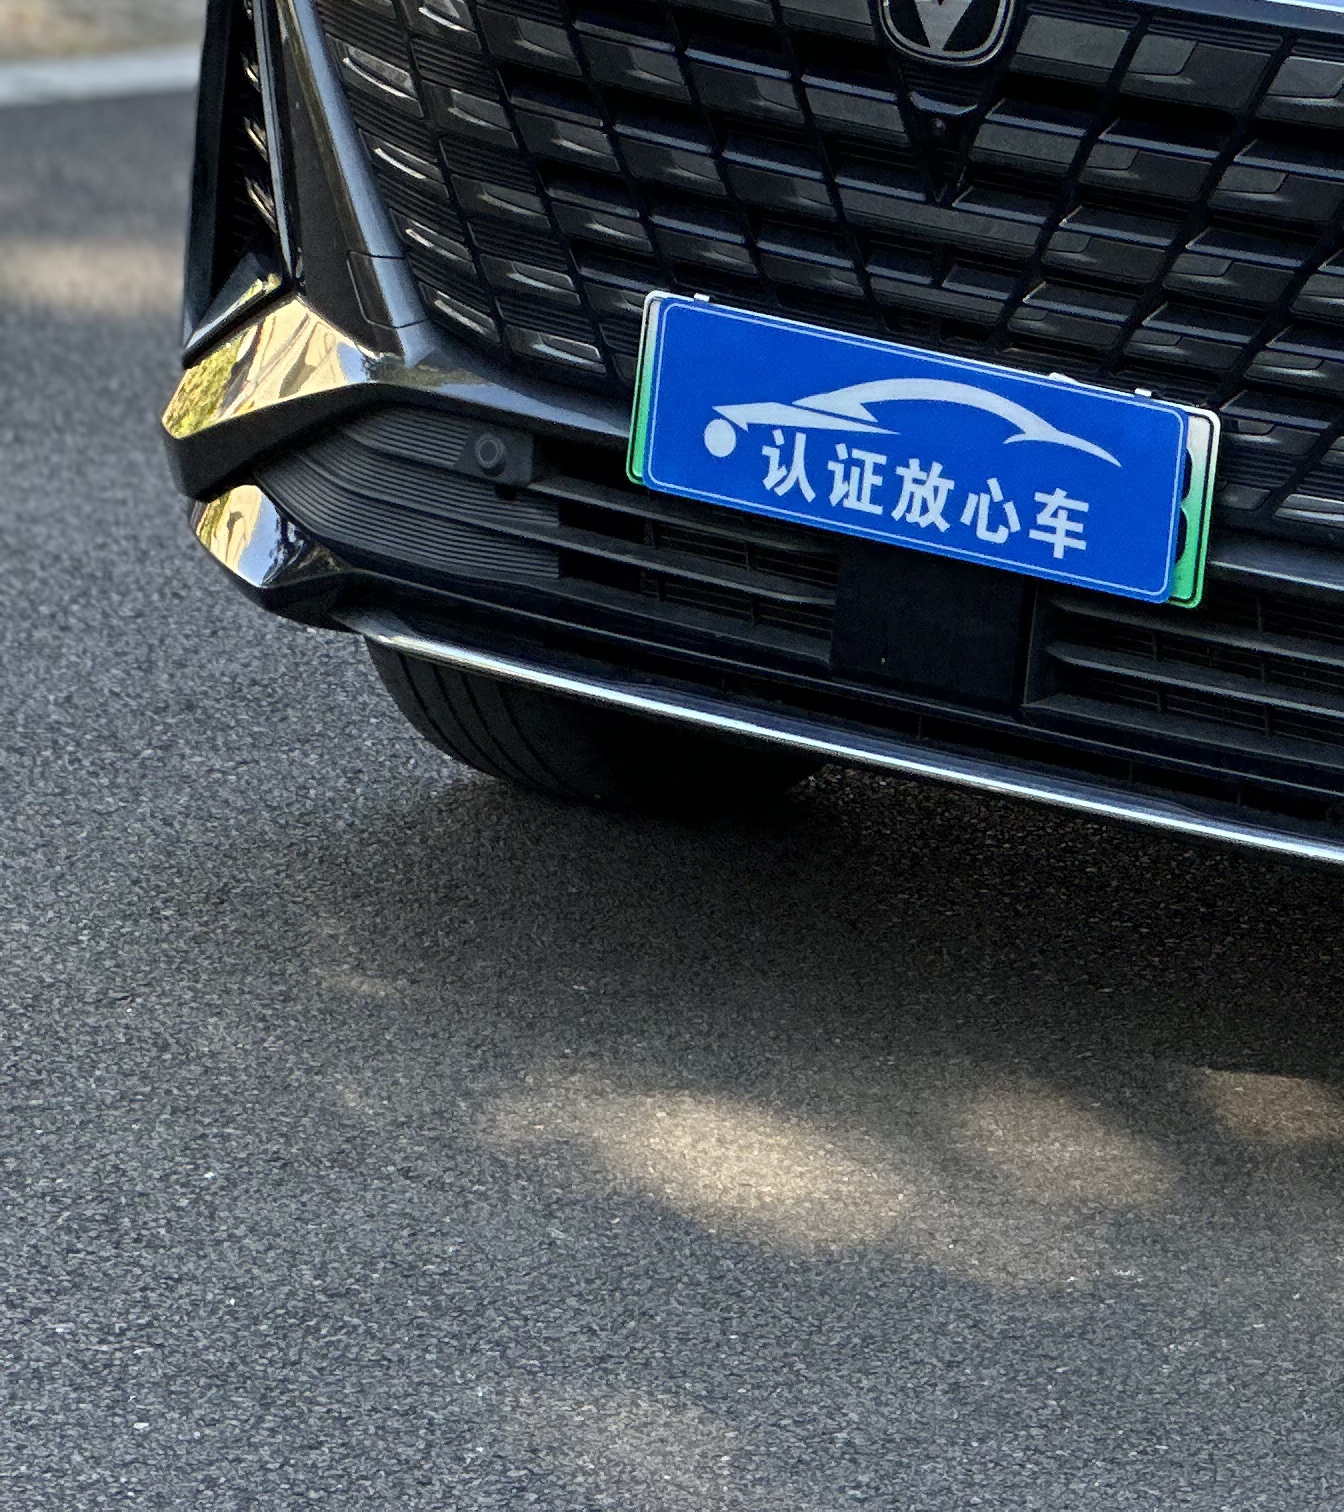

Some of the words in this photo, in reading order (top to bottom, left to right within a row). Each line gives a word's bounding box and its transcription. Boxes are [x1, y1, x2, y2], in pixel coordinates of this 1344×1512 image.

[761, 429, 1090, 560] 认证放心车
